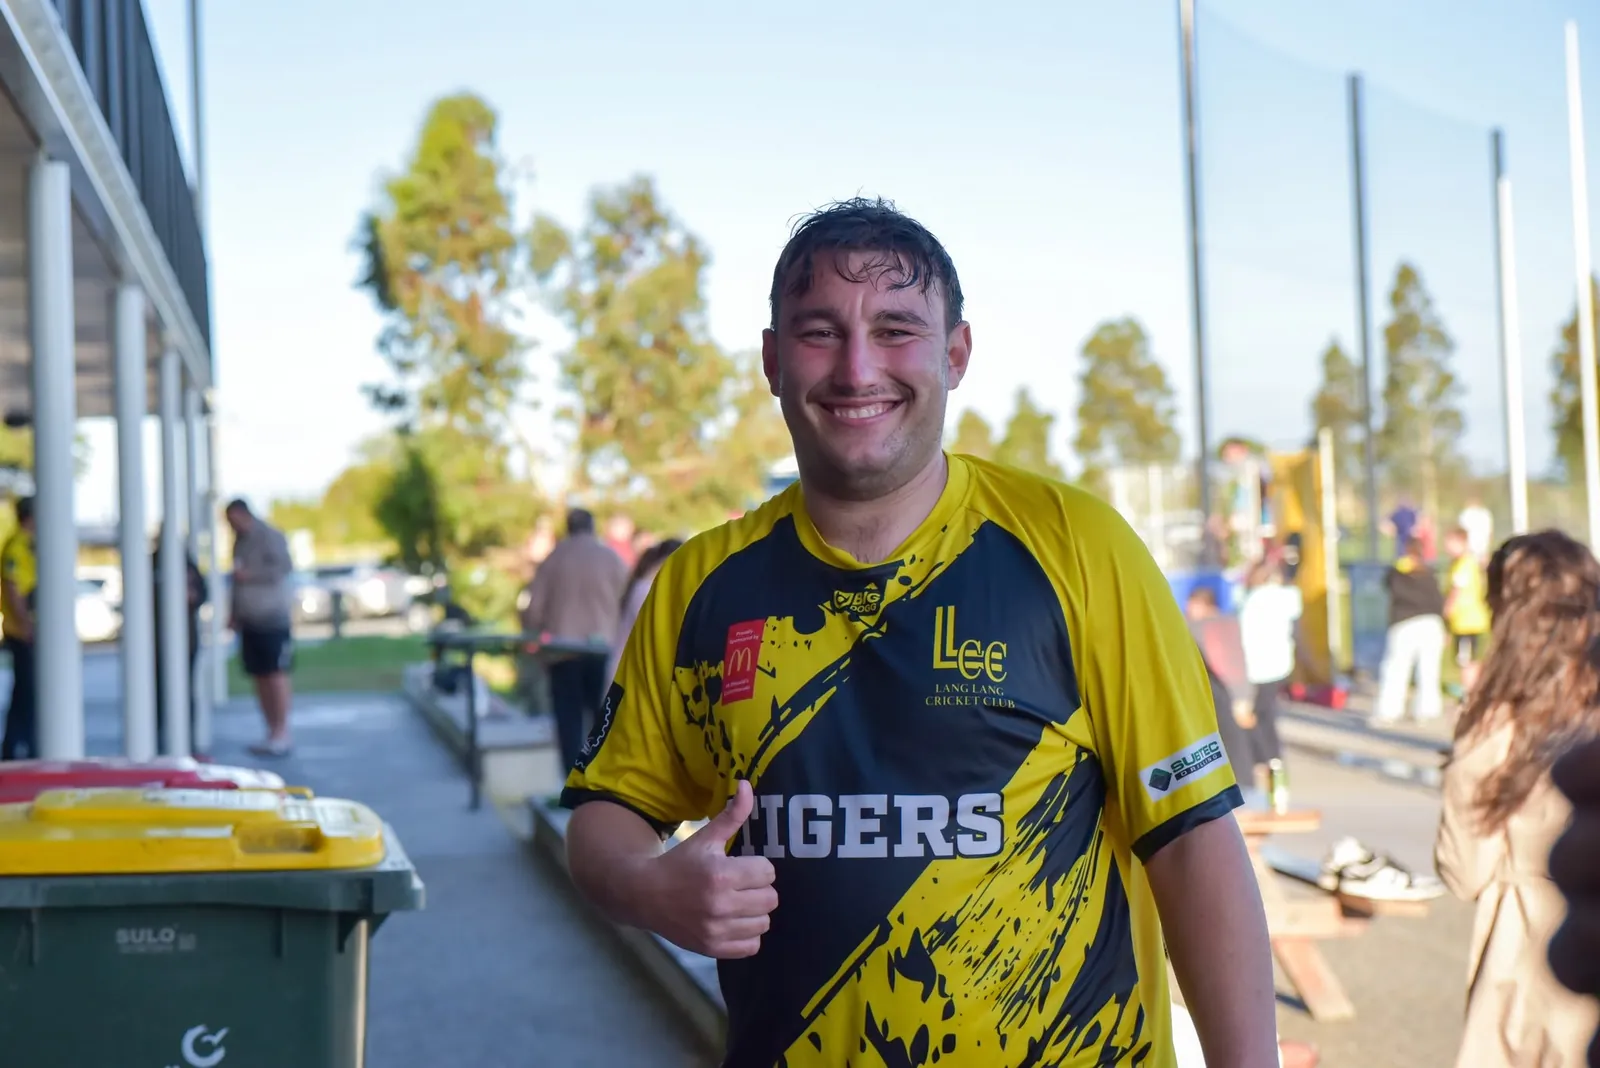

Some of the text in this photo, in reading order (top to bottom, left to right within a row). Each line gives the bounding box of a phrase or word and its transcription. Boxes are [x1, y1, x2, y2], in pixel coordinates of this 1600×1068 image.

[852, 591, 880, 605] BIG
[935, 683, 1004, 696] LANG LANG
[925, 695, 1015, 708] CRICKET CLUB
